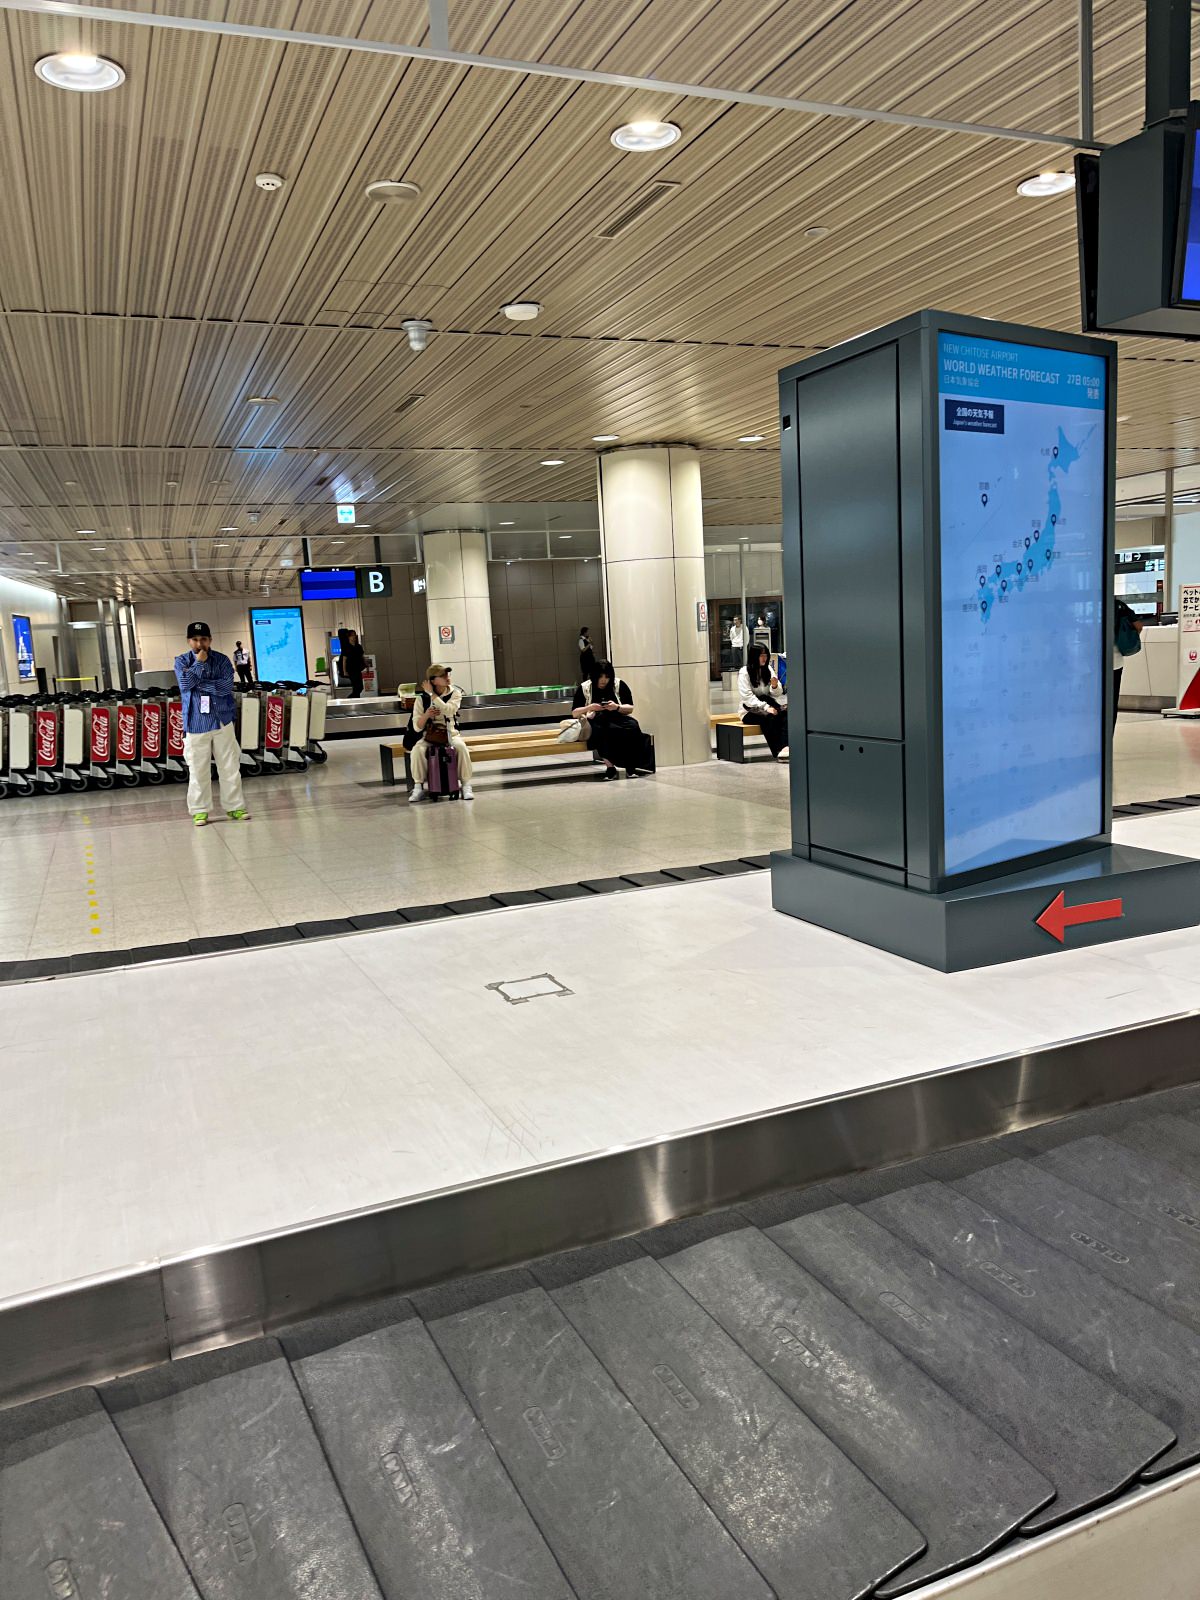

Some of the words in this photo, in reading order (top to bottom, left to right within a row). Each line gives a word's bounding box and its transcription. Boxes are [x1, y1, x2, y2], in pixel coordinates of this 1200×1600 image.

[943, 343, 960, 355] NEW
[961, 345, 989, 359] CHITOSE
[991, 349, 1019, 363] AIRPORT
[943, 359, 976, 374] WORLD
[978, 364, 1018, 380] WEATHER
[1019, 369, 1060, 385] FORECAST
[956, 406, 995, 420] 全国の天気予報
[368, 571, 385, 593] B
[39, 717, 55, 761] Coca-Cola
[92, 713, 108, 757] Coca-Cola
[118, 711, 134, 755] Coca-Cola
[144, 709, 159, 752] Coca-Cola
[267, 701, 282, 743] Coca-Cola
